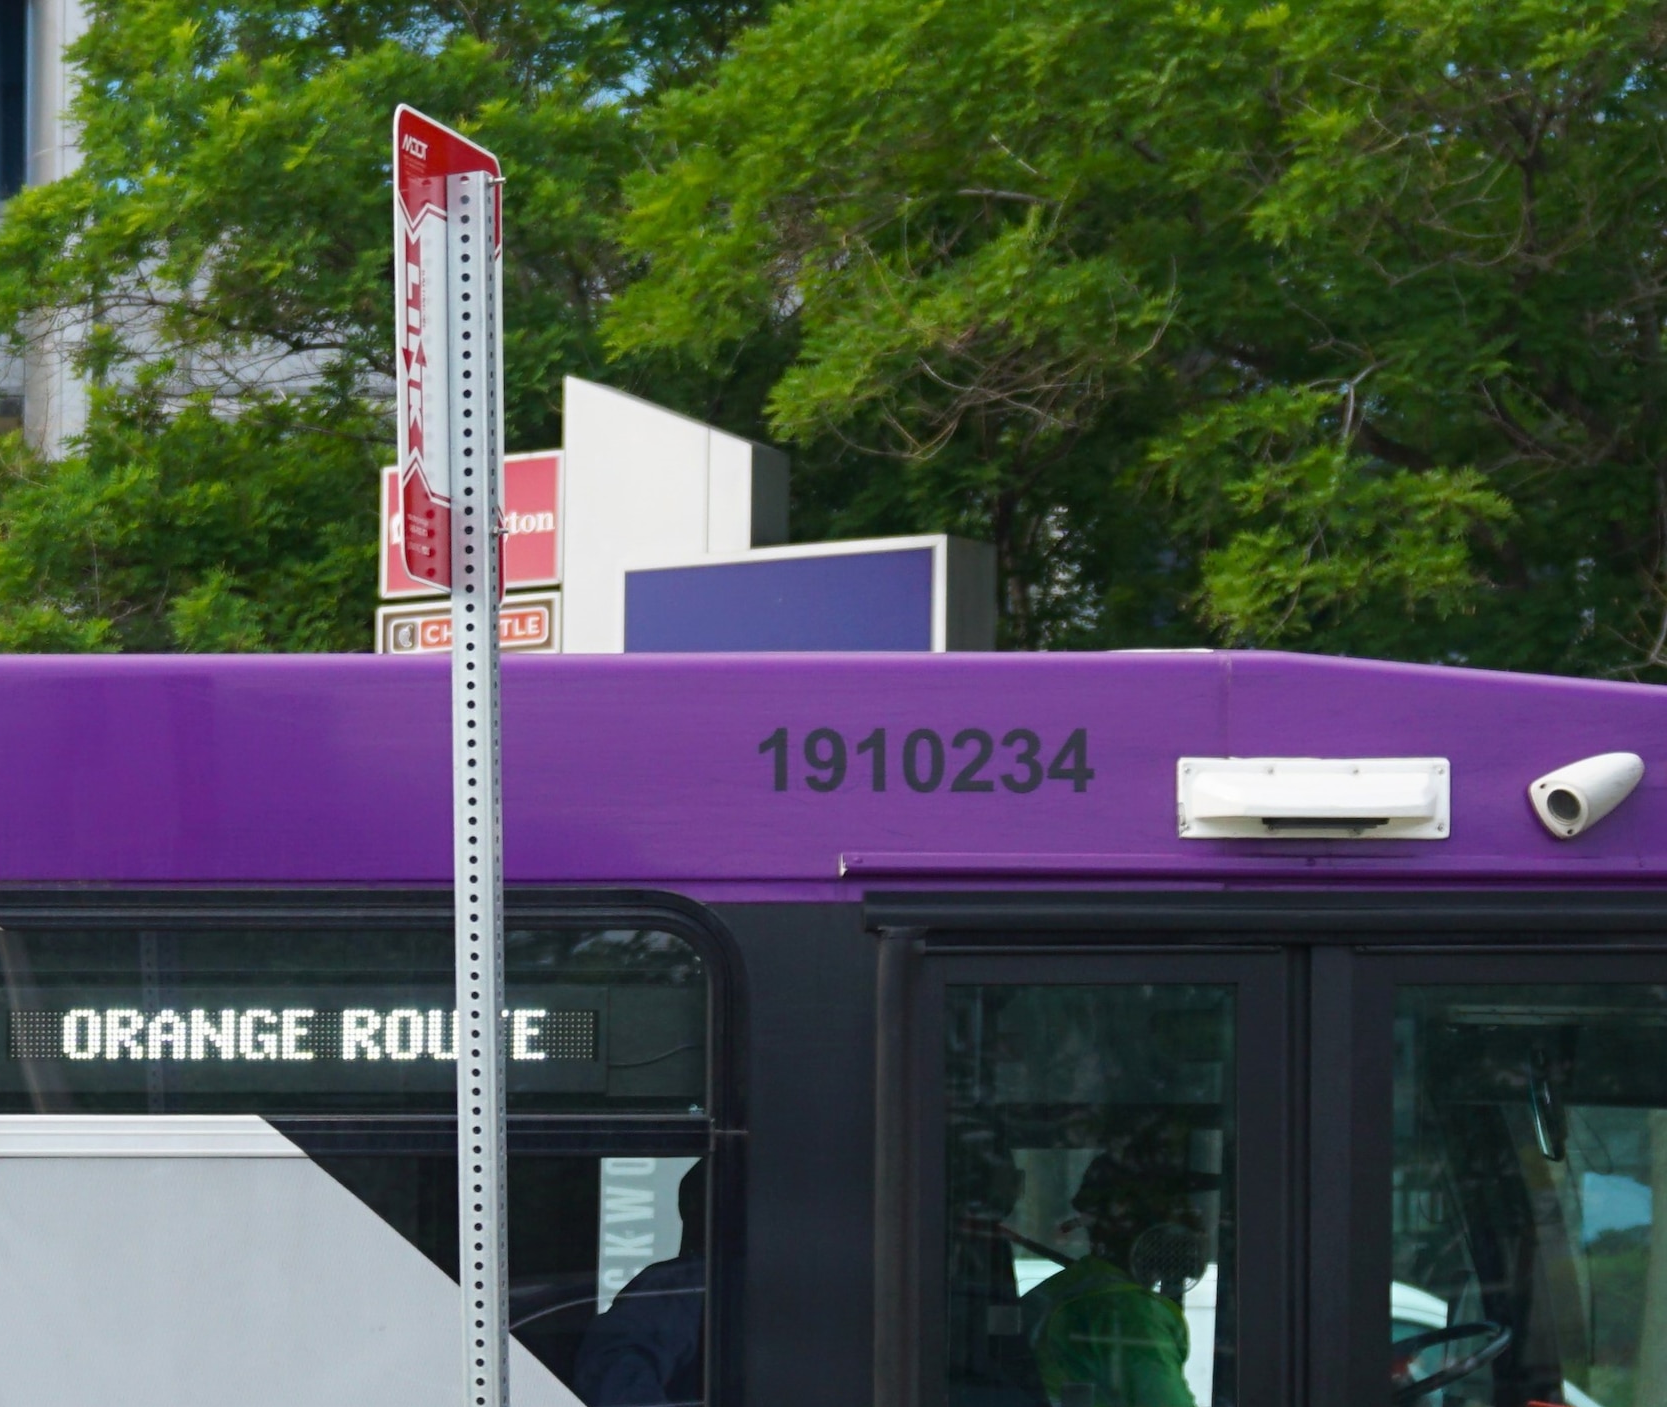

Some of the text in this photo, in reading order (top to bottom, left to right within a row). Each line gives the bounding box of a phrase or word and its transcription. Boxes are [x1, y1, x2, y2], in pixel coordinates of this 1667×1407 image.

[426, 615, 540, 643] CHTLE
[757, 727, 1095, 794] 1910234
[63, 1009, 547, 1060] ORANGE ROUE
